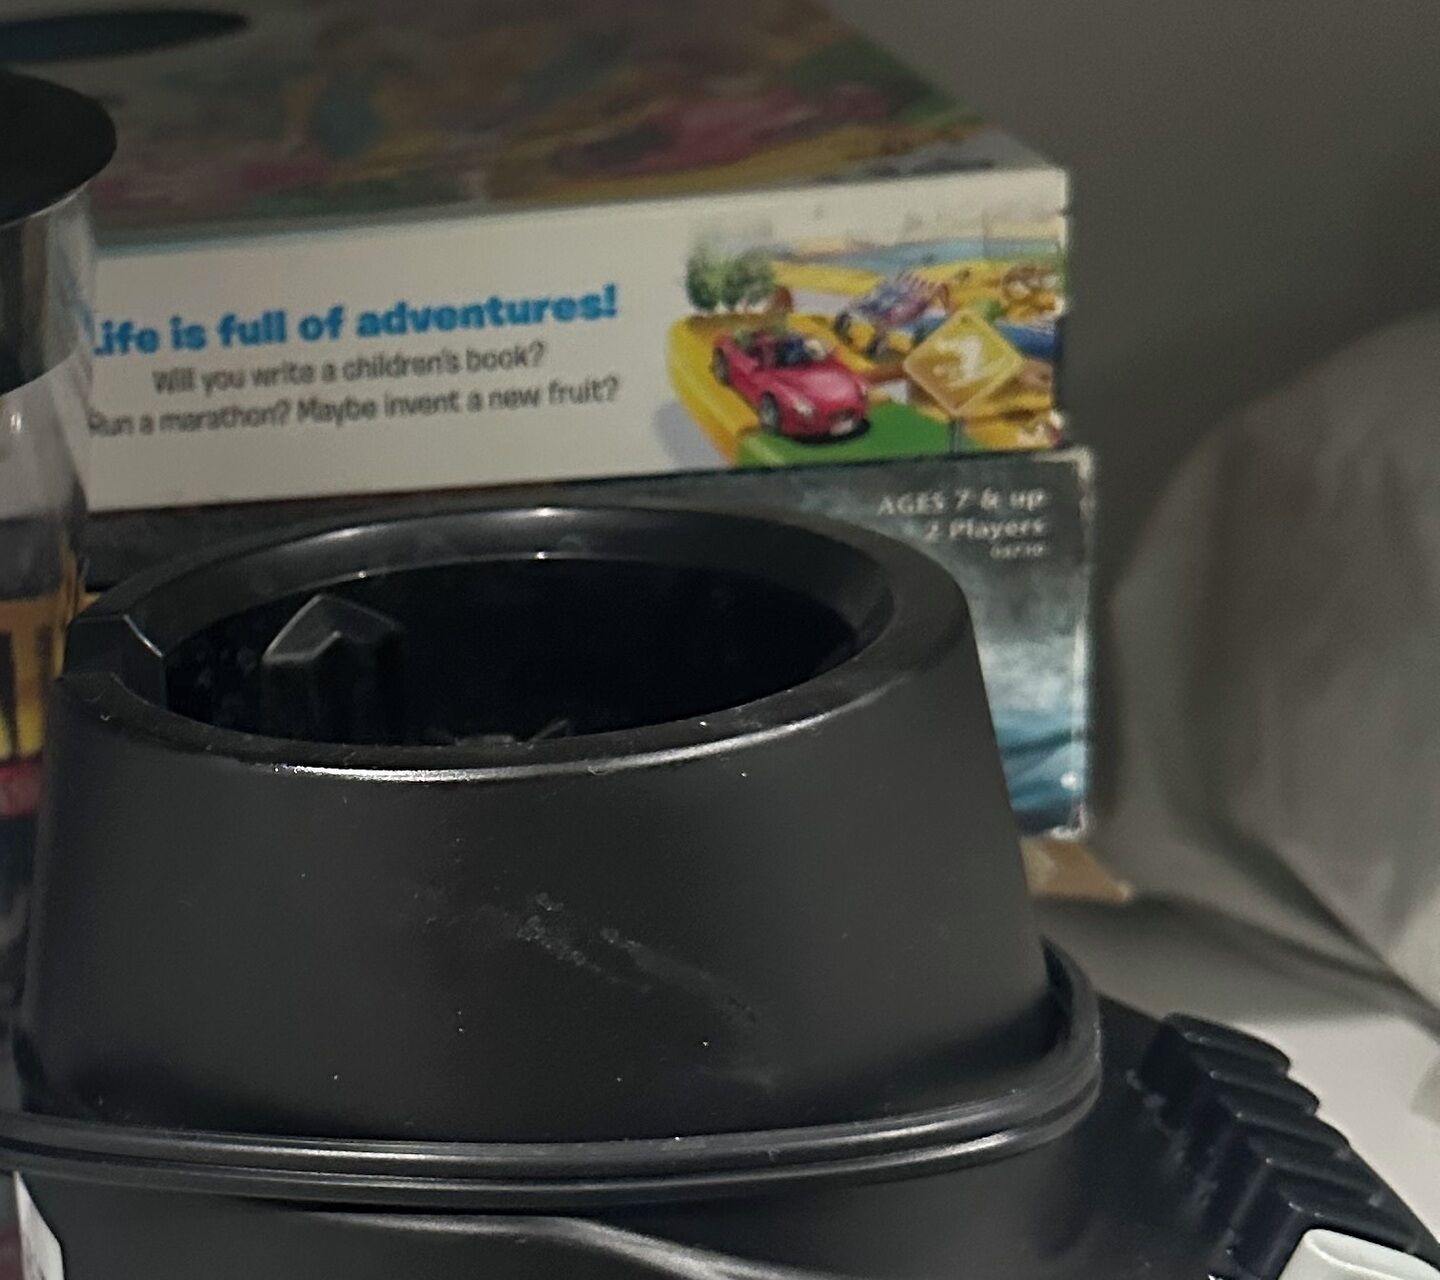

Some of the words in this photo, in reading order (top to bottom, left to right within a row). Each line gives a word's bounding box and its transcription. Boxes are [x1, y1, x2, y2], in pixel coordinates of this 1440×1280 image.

[82, 303, 159, 357] Life
[169, 316, 207, 351] is
[217, 309, 288, 348] full
[298, 304, 345, 342] of
[357, 282, 619, 338] adventures!
[152, 367, 196, 394] Will
[201, 370, 246, 397] you
[251, 359, 315, 387] write
[321, 363, 336, 382] a
[341, 347, 460, 382] children's
[465, 340, 546, 373] book?
[139, 414, 154, 436] a
[159, 398, 292, 431] marathon?
[297, 393, 378, 428] Maybe
[384, 389, 461, 417] invent
[467, 391, 483, 413] a
[488, 387, 541, 410] new
[548, 374, 620, 406] fruit?
[878, 489, 947, 516] AGES
[955, 487, 971, 511] 7
[948, 516, 1048, 541] Players
